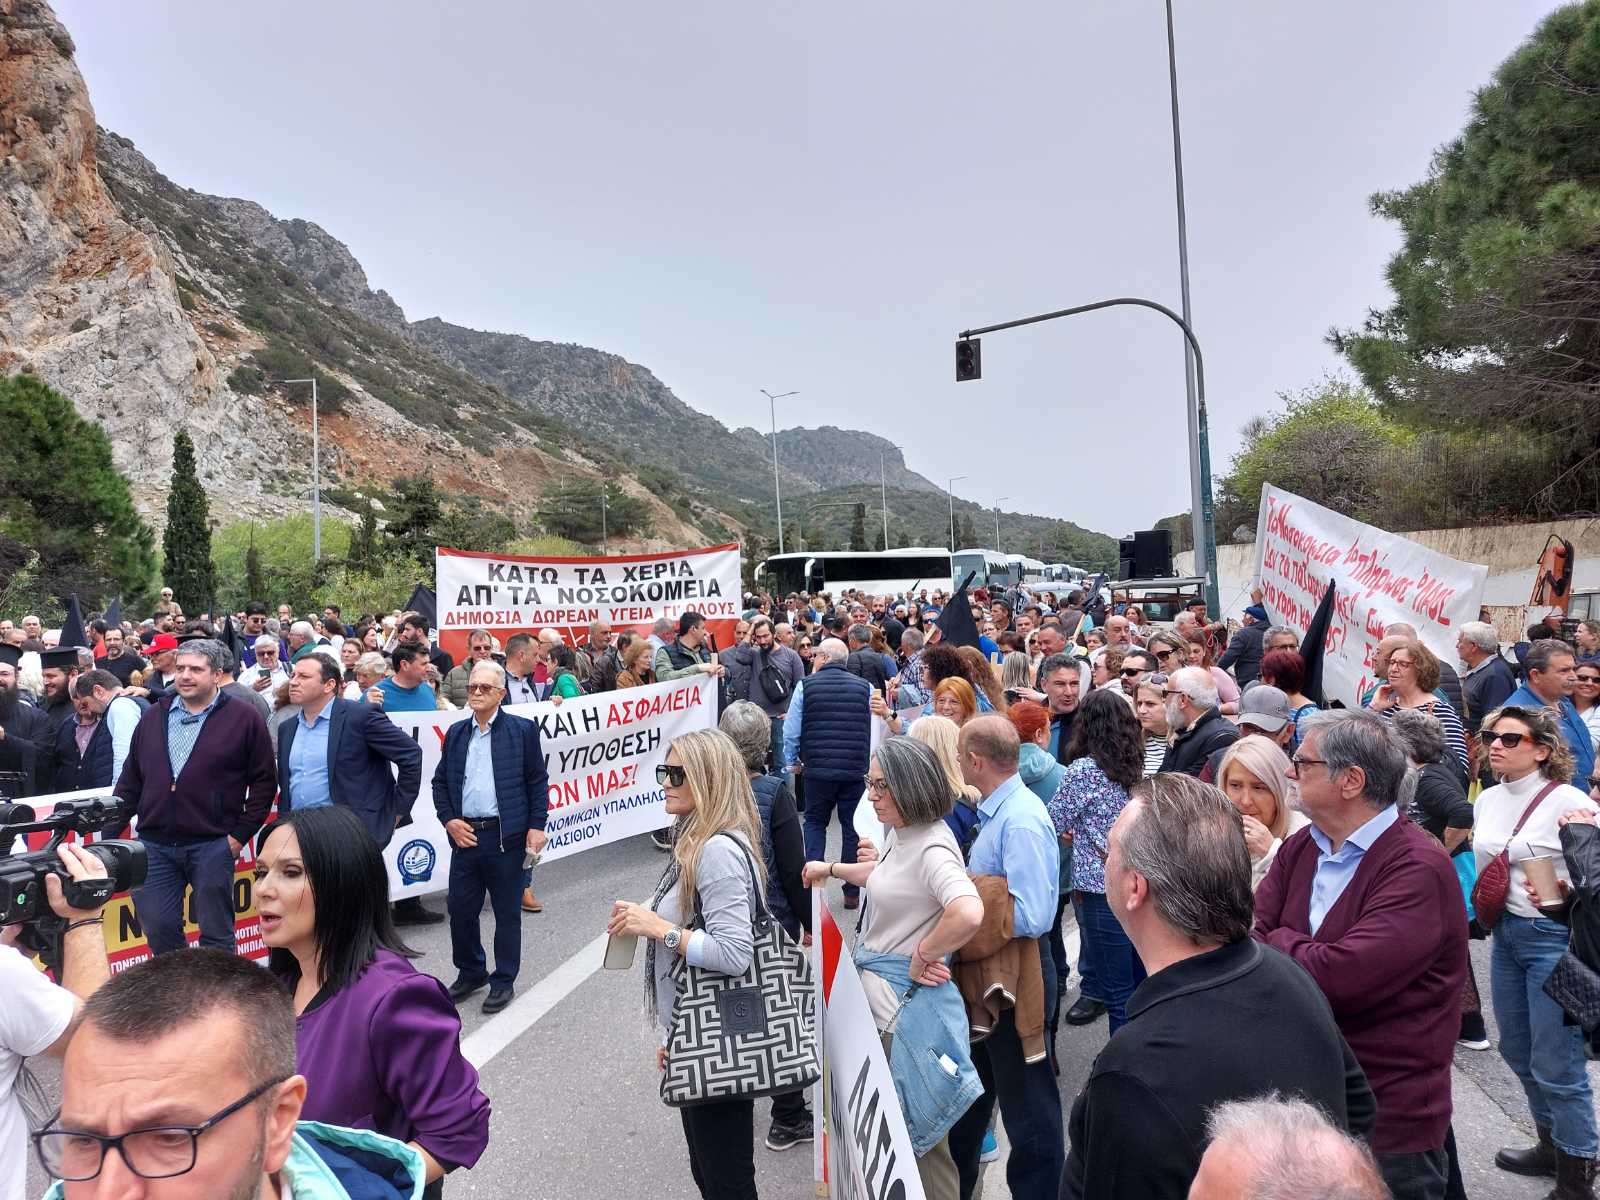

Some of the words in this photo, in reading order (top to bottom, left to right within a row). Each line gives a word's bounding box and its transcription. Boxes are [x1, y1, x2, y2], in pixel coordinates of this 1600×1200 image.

[488, 563, 558, 585] ΚΑΤΩ
[574, 567, 606, 585] ΤΑ
[623, 559, 694, 583] ΧΕΡΙΑ
[507, 586, 542, 605] ΤΑ
[558, 578, 722, 605] ΝΟΣΟΚΟΜΕΙΑ
[444, 610, 522, 625] ΔΗΜΟΣΙΑ
[532, 608, 599, 624] ΔΩΡΕΑΝ
[609, 606, 654, 621] ΥΓΕΙΑ
[534, 712, 577, 739] ΚΑΙ
[582, 706, 600, 732] Η
[607, 685, 702, 728] ΑΣΦΑΛΕΙΑ
[558, 727, 661, 774] ΥΠΟΘΕΣΗ
[547, 779, 580, 811] ΩΝ
[587, 763, 639, 800] ΜΑΣ!
[545, 806, 600, 833] ΝΟΜΙΚΩΝ
[603, 789, 666, 818] ΥΠΑΛΛΗΛΩ
[546, 822, 603, 851] ΛΑΣΙΘΙΟΥ
[93, 889, 108, 897] JVC
[237, 939, 266, 956] ΝΗΠΙΑ
